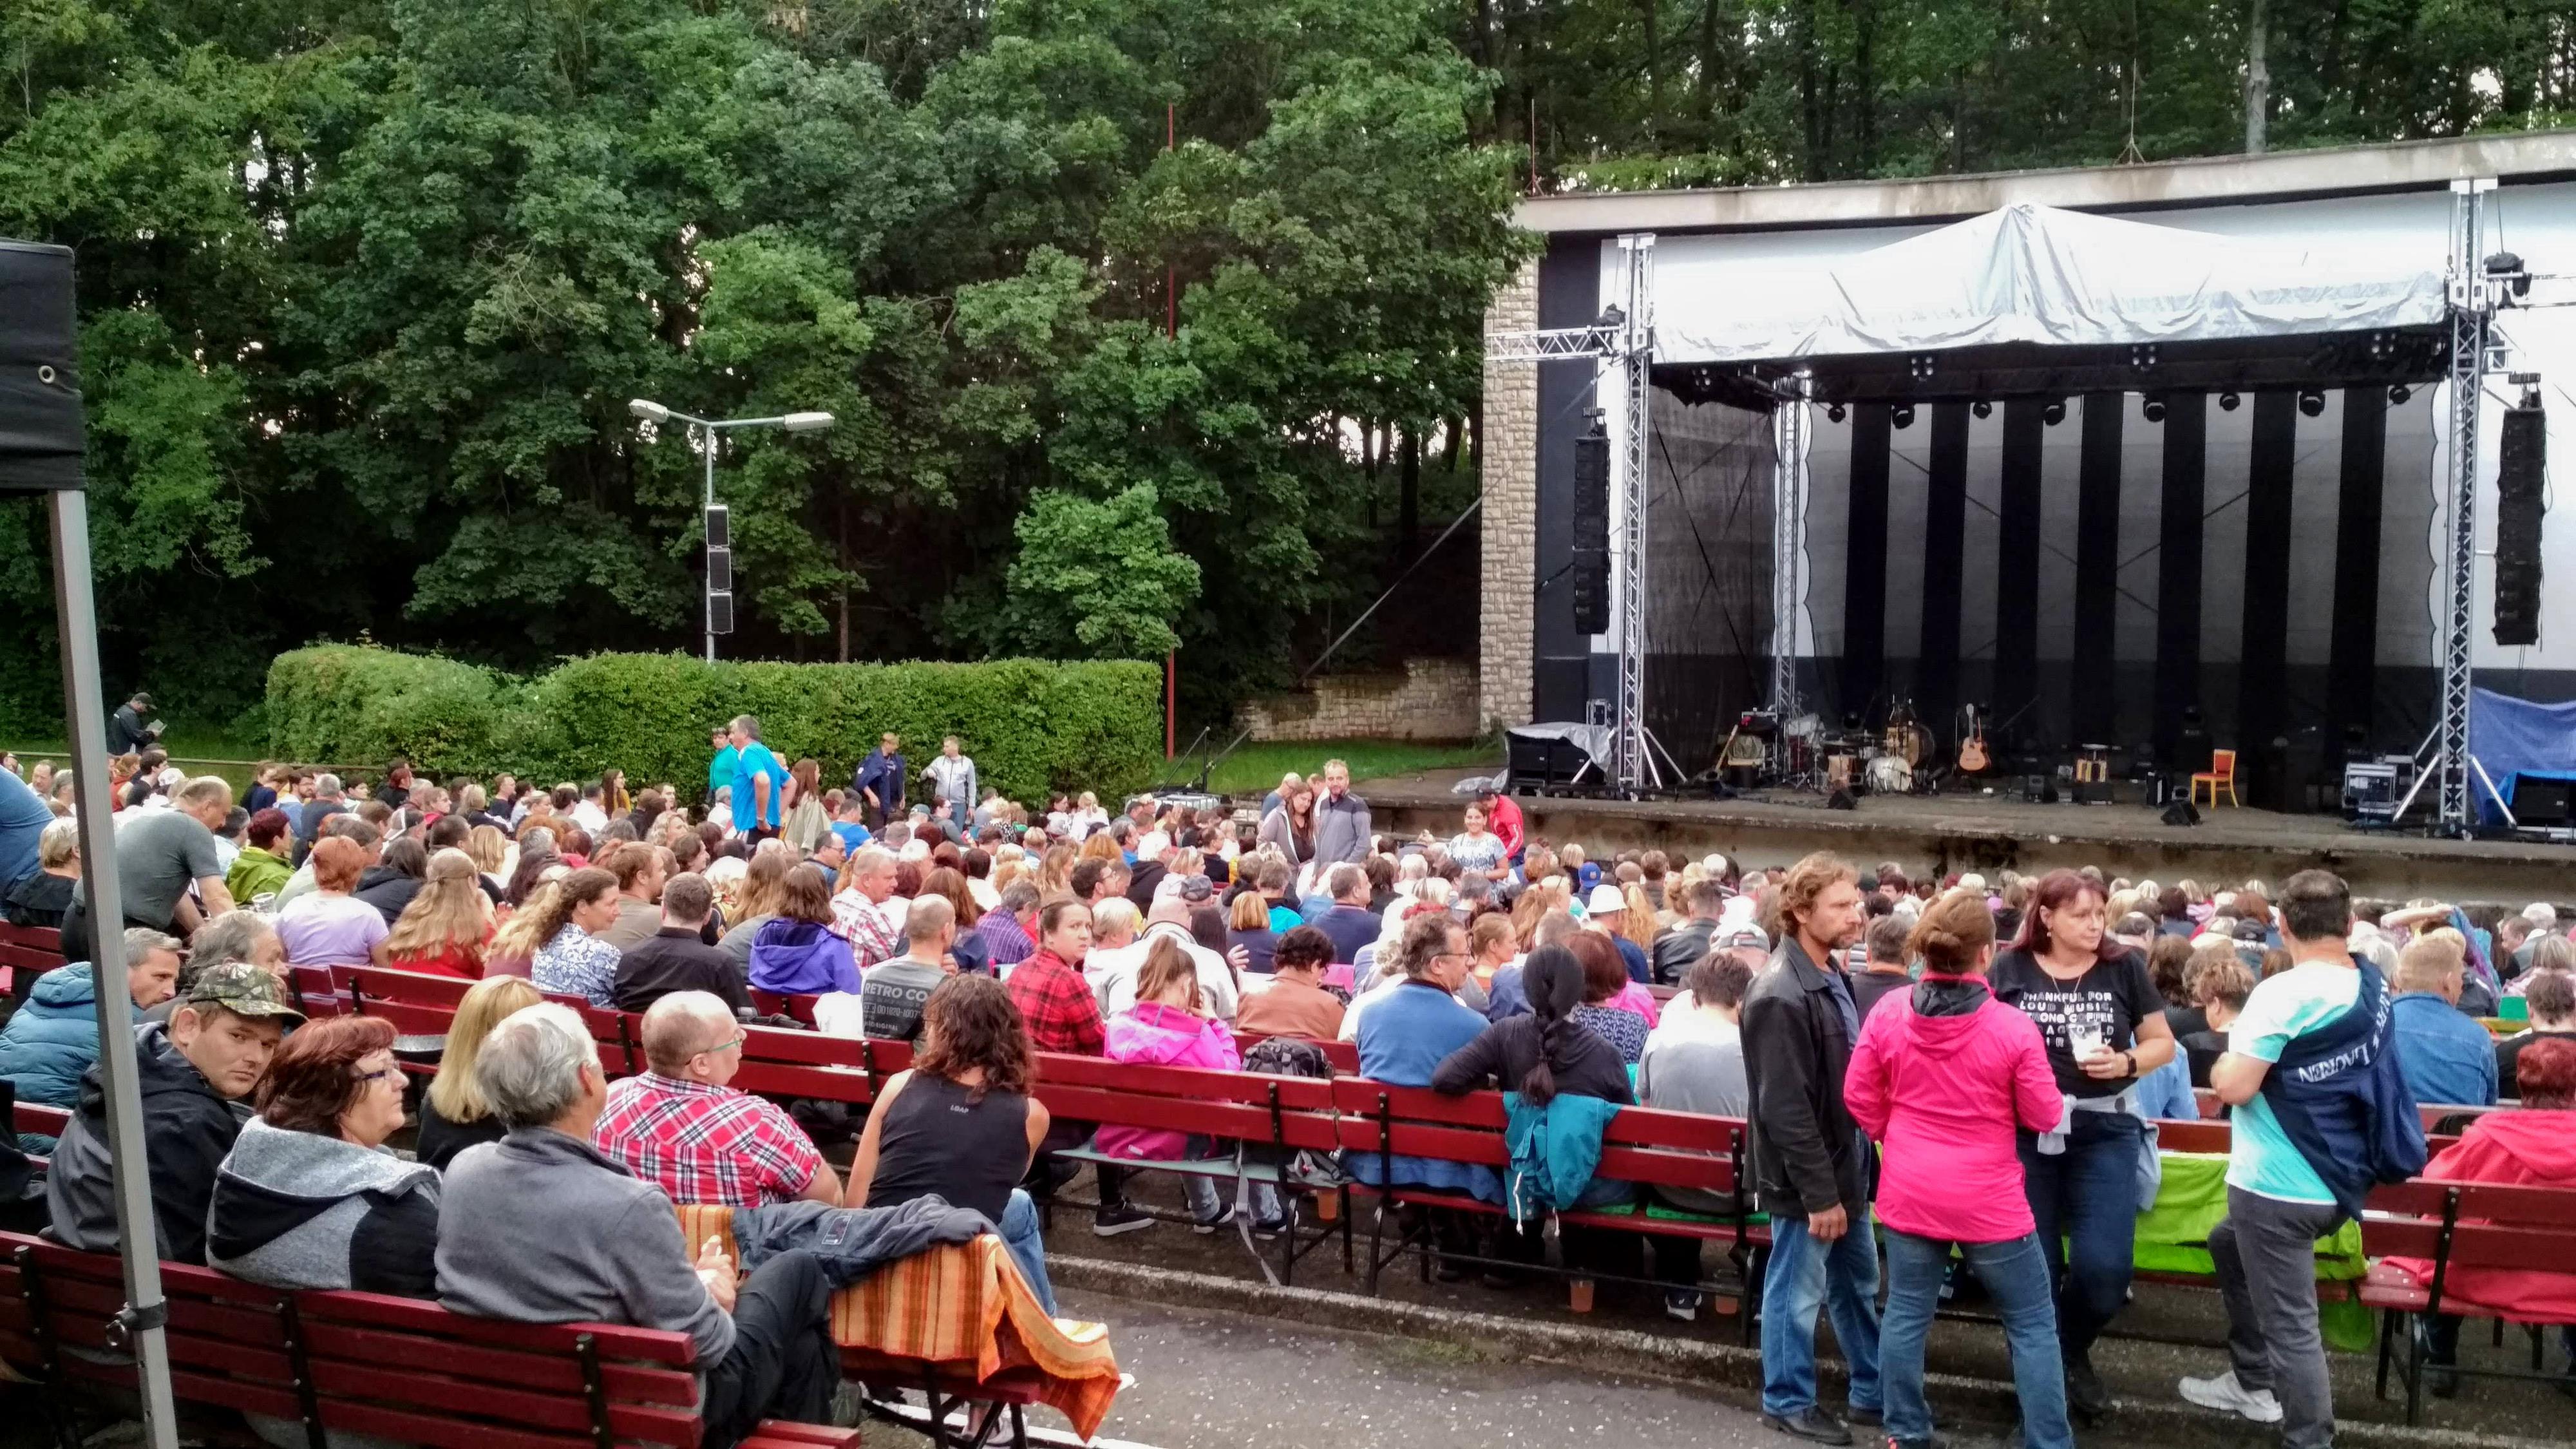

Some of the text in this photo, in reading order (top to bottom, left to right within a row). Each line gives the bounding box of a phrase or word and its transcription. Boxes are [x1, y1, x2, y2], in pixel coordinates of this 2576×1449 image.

[864, 983, 903, 999] RETRO
[2023, 991, 2112, 1003] THANKFUL FOR
[2020, 1000, 2056, 1012] LOUD
[2027, 1012, 2066, 1024] TRONG
